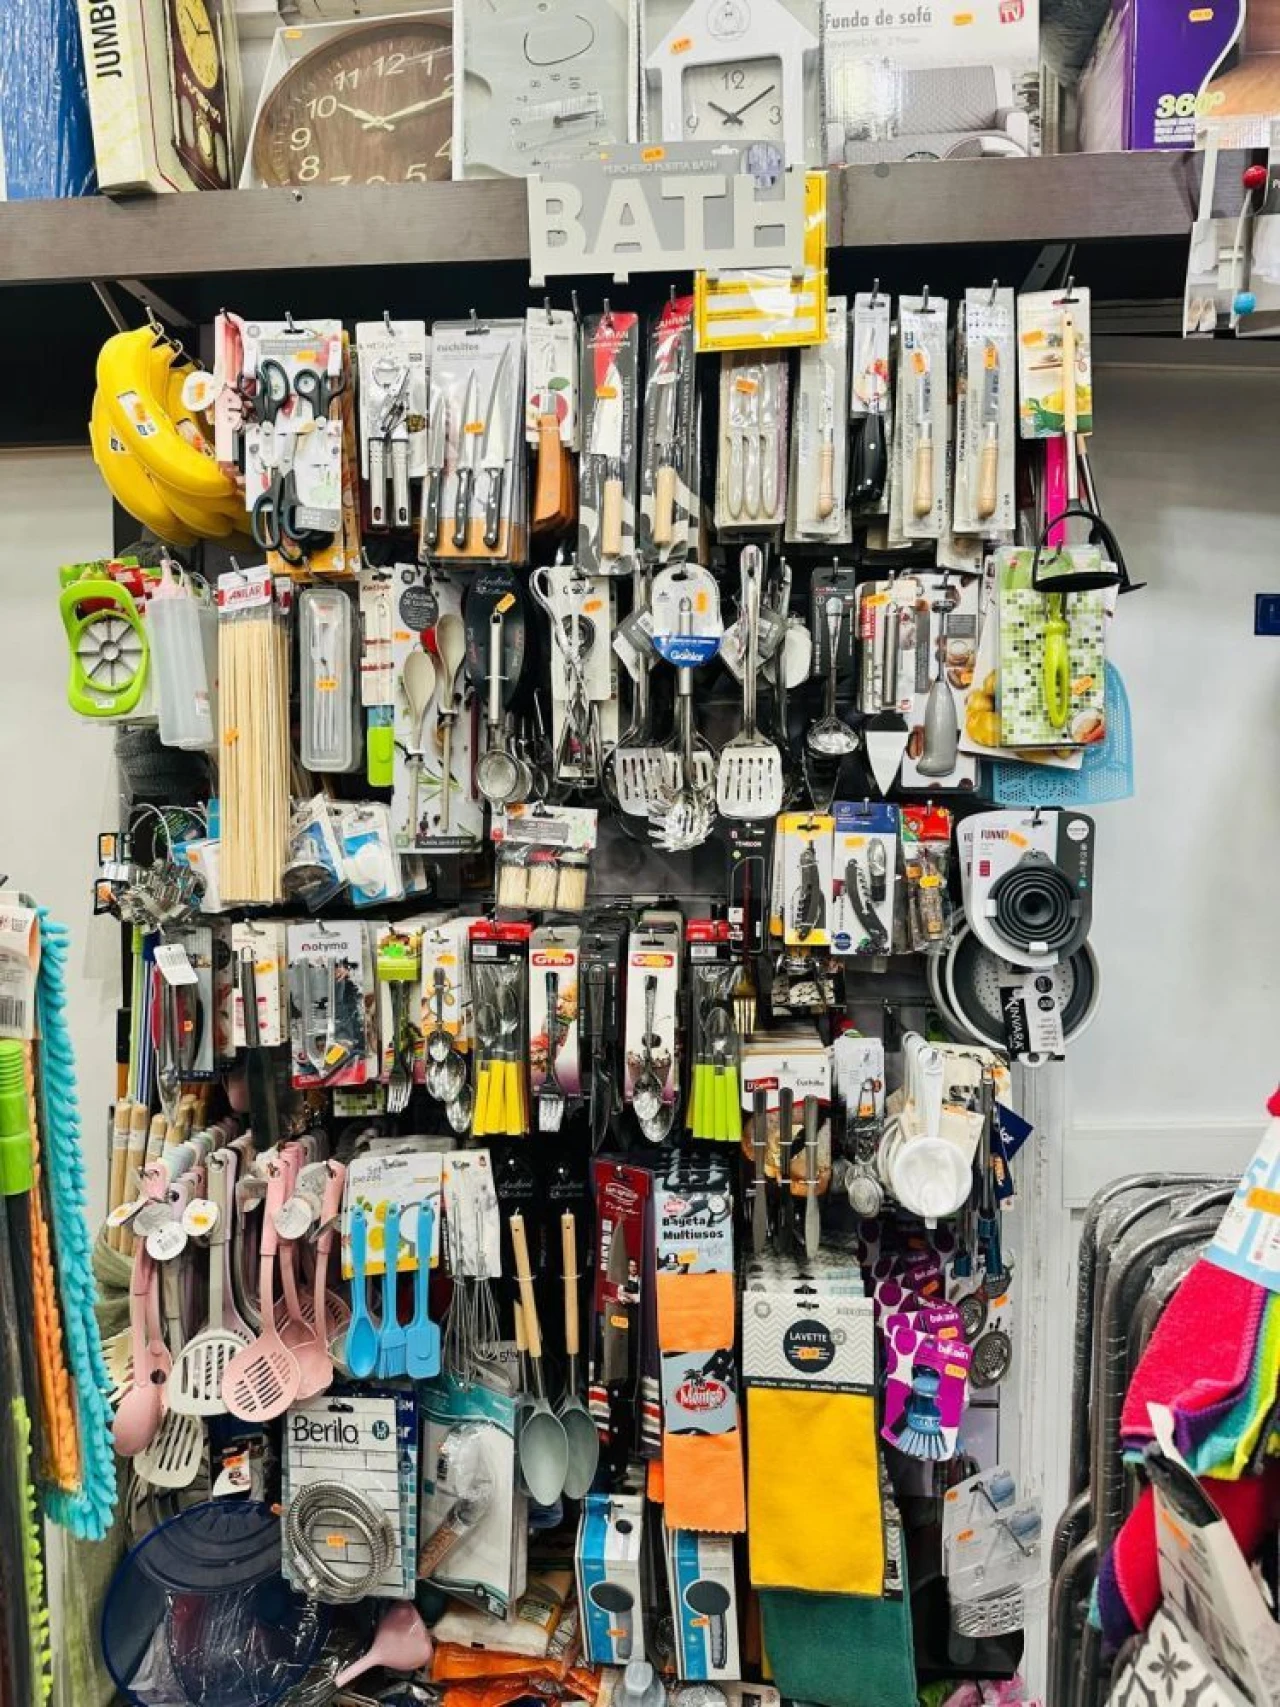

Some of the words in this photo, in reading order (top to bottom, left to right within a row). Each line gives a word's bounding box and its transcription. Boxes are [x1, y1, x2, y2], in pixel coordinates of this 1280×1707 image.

[875, 9, 893, 26] de
[900, 5, 932, 24] sofá
[88, 0, 123, 78] JUMB
[373, 53, 406, 77] 12
[334, 68, 360, 91] 11
[720, 69, 745, 90] 12
[307, 95, 337, 119] 10
[769, 105, 782, 125] 3
[290, 127, 311, 151] 9
[298, 155, 320, 181] 8
[530, 166, 805, 272] BATH
[663, 1230, 724, 1240] Multiusos
[789, 1331, 827, 1343] LAVETTE
